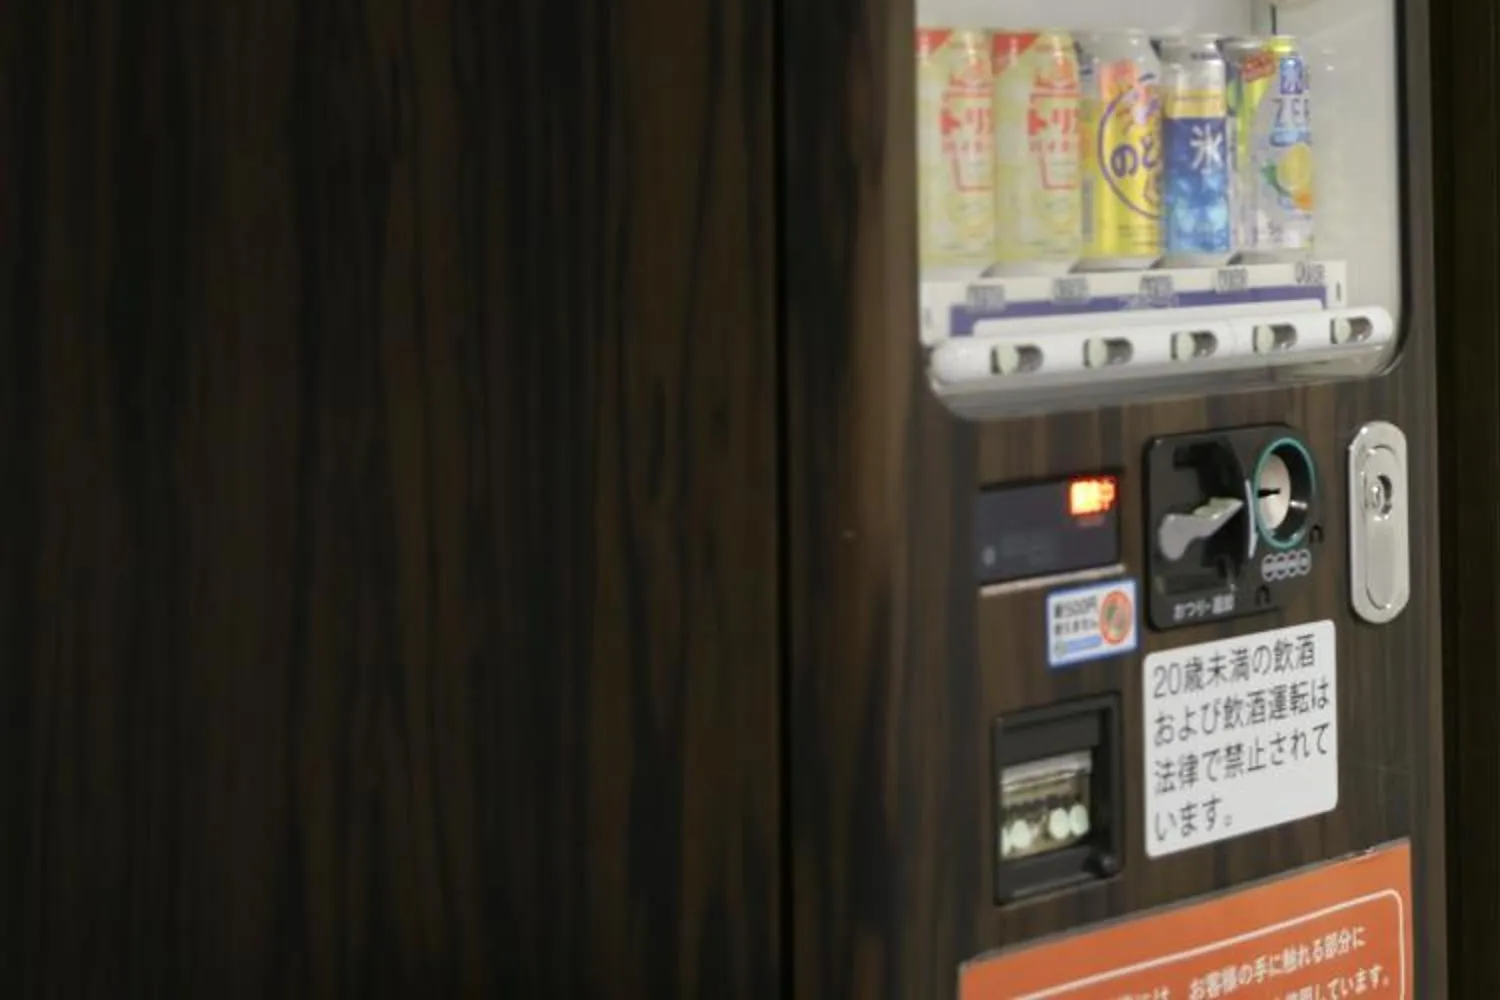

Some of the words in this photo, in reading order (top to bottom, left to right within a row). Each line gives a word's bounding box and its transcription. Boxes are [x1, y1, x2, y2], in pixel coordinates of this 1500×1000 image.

[1153, 633, 1315, 698] 20歳未満の飲酒
[1154, 676, 1330, 747] および飲酒運転は
[1154, 722, 1331, 794] 法律で禁止されて
[1154, 795, 1233, 842] います。
